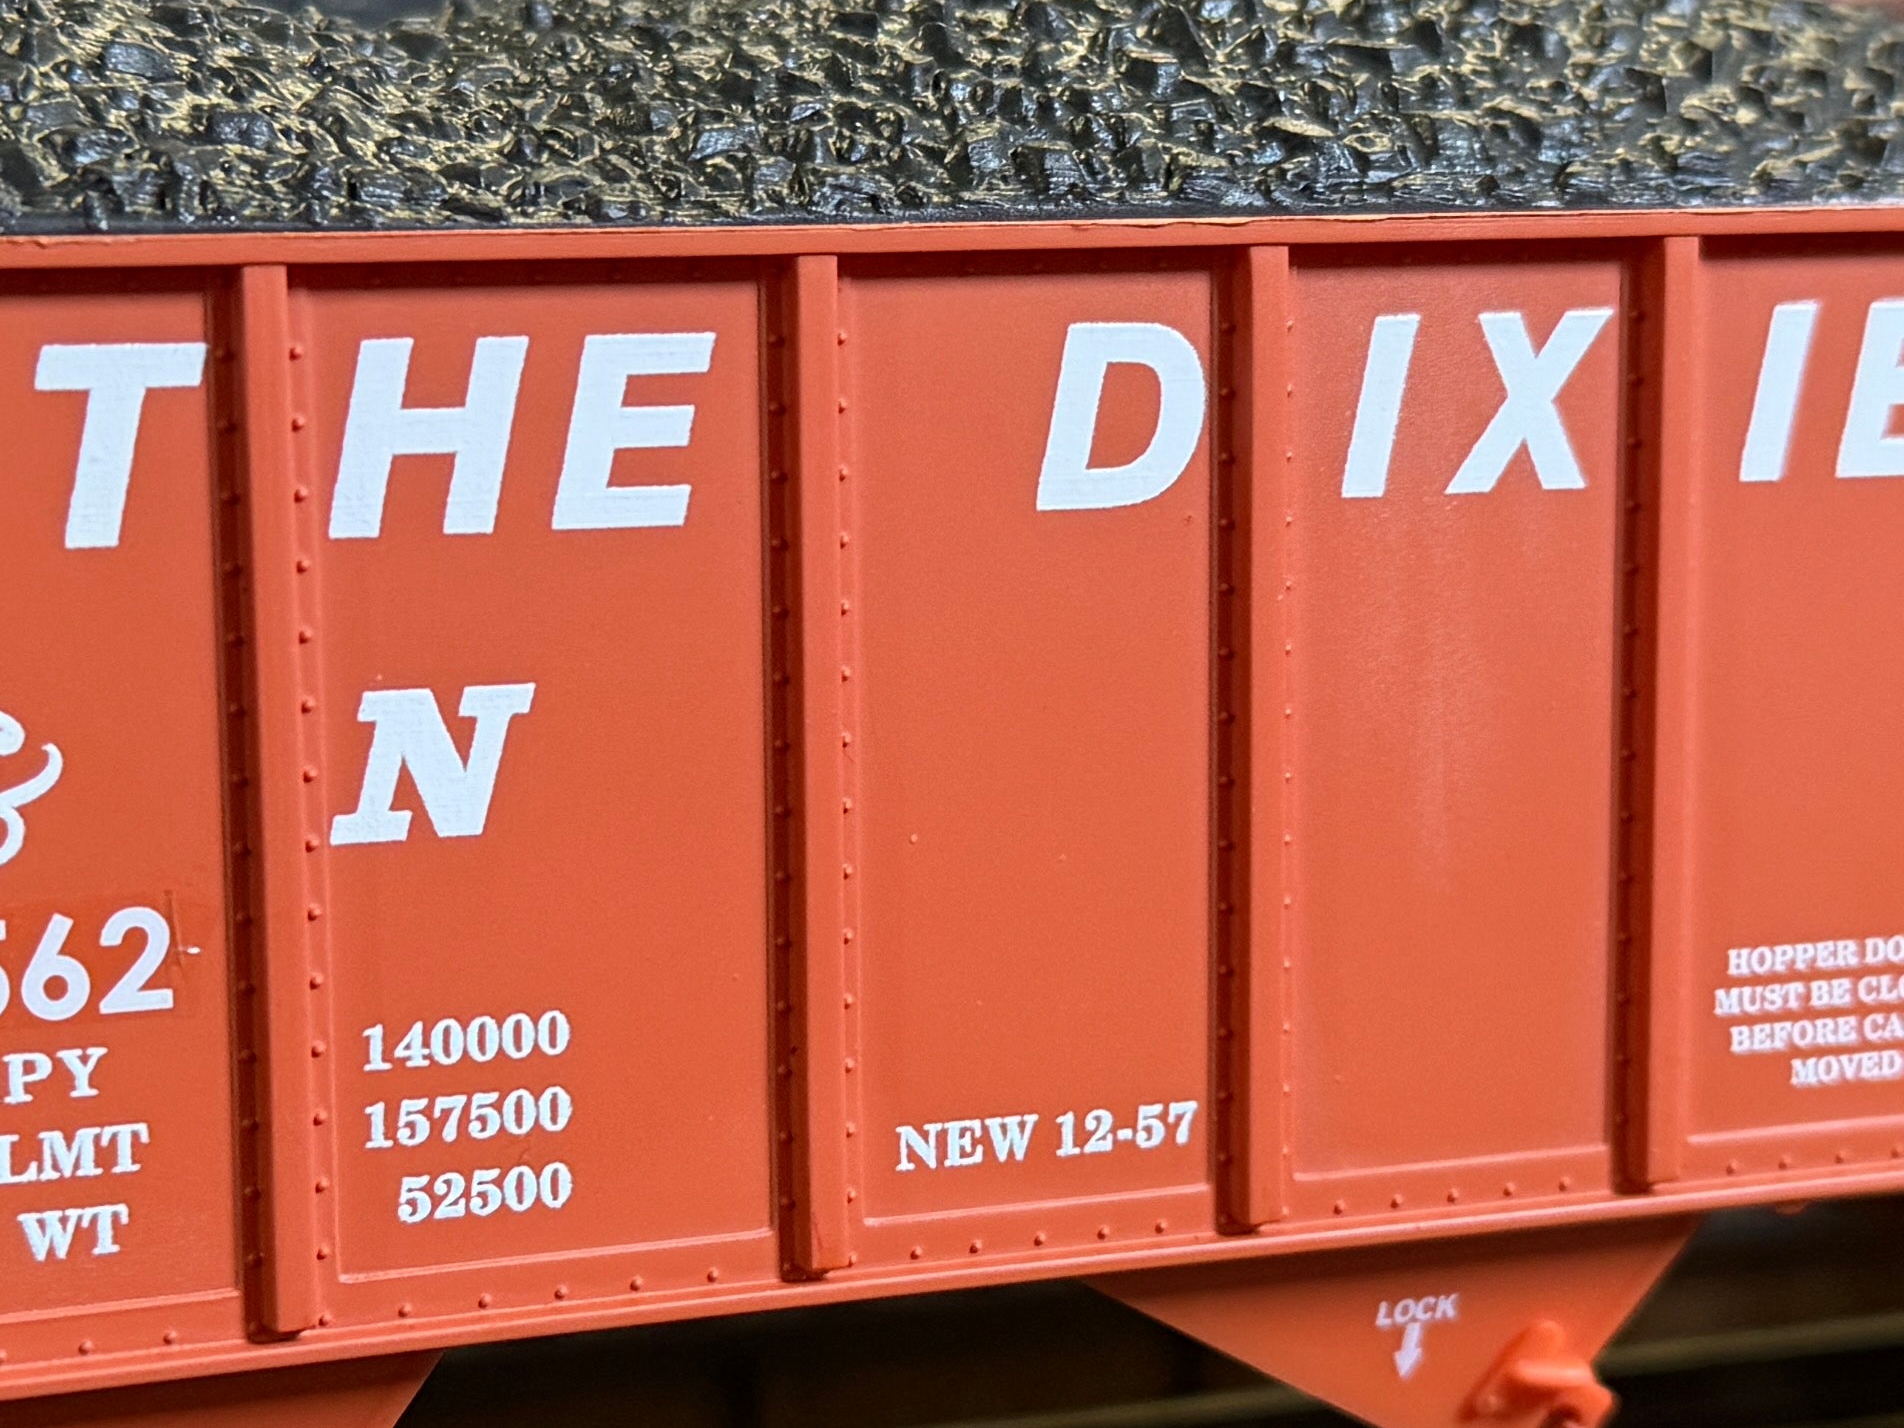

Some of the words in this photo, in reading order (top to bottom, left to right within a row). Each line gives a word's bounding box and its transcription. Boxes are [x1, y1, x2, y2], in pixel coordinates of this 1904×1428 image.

[32, 330, 718, 551] THE
[328, 681, 538, 848] N
[1727, 939, 1860, 977] HOPPER
[1713, 981, 1805, 1017] MUST
[1810, 977, 1852, 1009] BE
[361, 1009, 572, 1073] 140000
[1729, 1014, 1859, 1054] BEFORE
[363, 1084, 574, 1150] 157500
[894, 1112, 1036, 1173] NEW
[1054, 1099, 1200, 1159] 12-57
[396, 1160, 574, 1225] 52500
[17, 1202, 130, 1263] WT
[1374, 1292, 1460, 1328] LOCK
